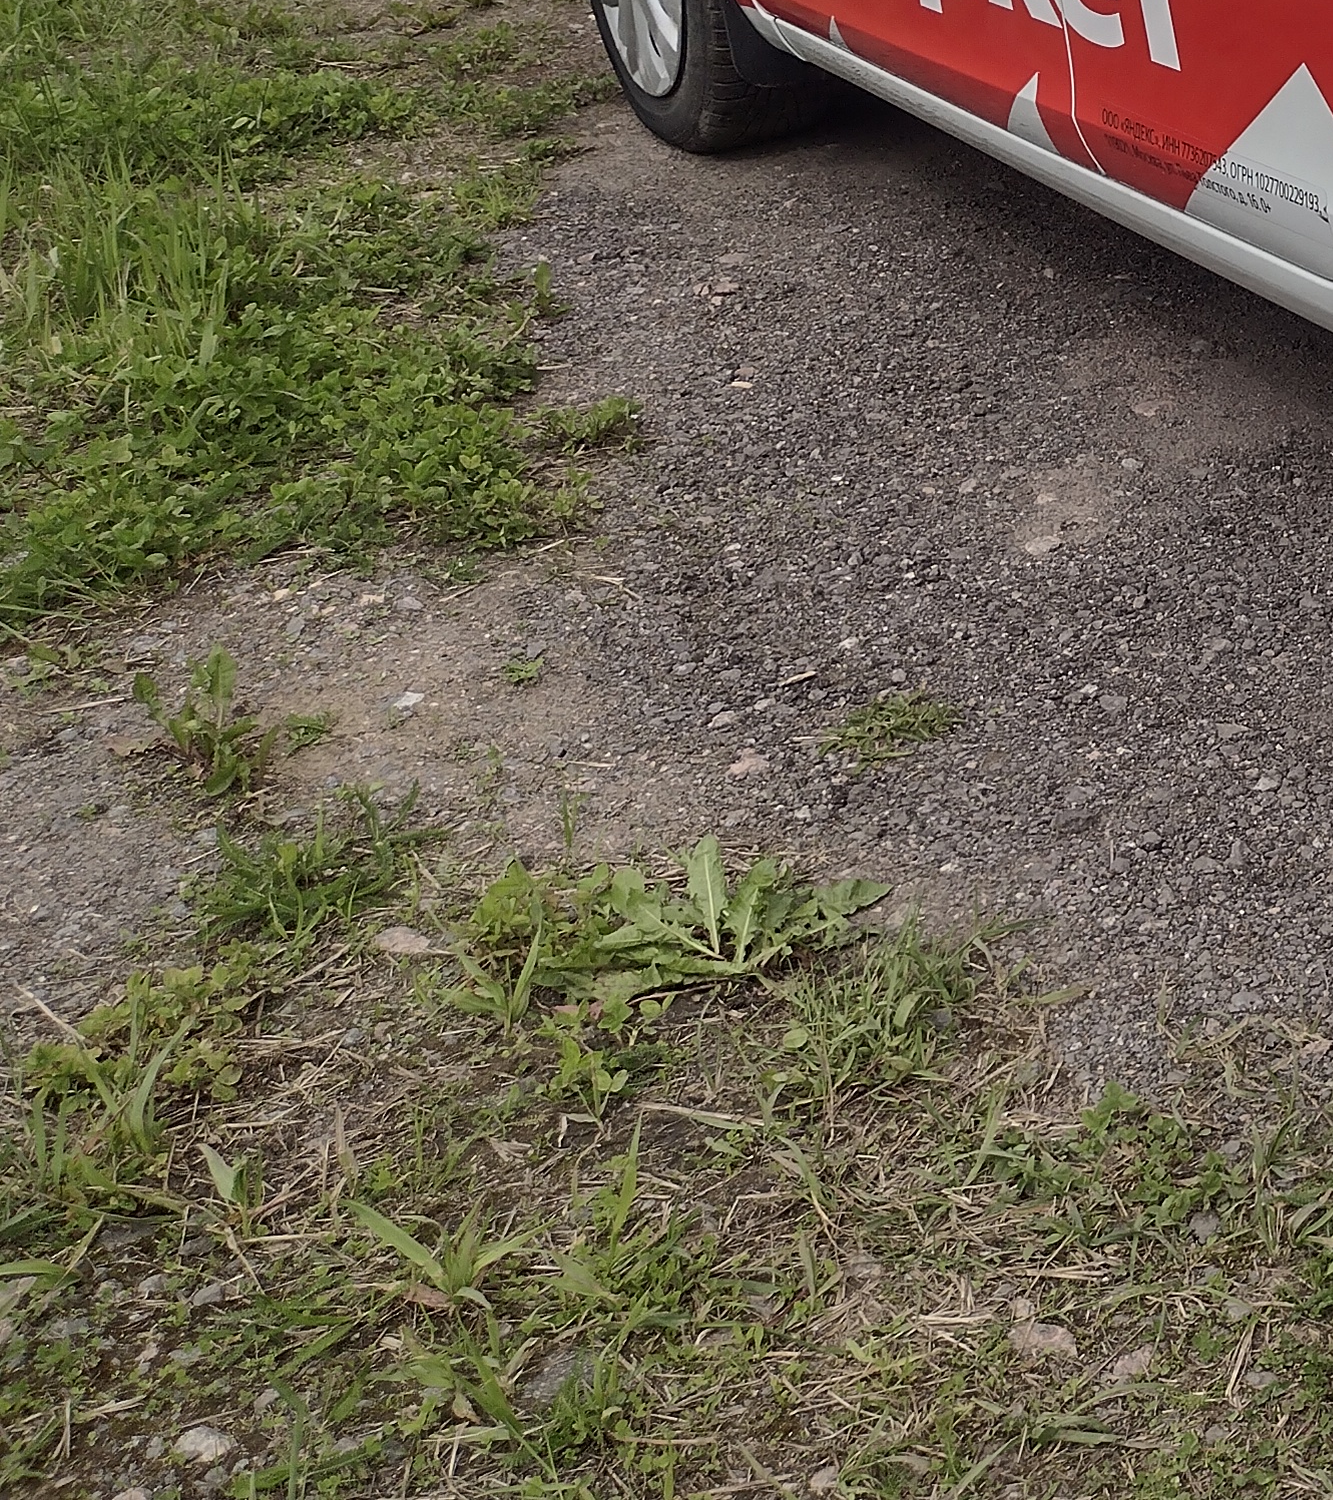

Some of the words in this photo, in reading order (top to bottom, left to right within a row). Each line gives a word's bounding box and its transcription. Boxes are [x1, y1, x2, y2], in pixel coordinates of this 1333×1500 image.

[1102, 108, 1119, 129] ООО
[1162, 133, 1180, 156] ИНН
[1181, 140, 1229, 178] 7736207543,
[1230, 161, 1254, 186] ОГРН
[1254, 171, 1323, 214] 1027700229193,
